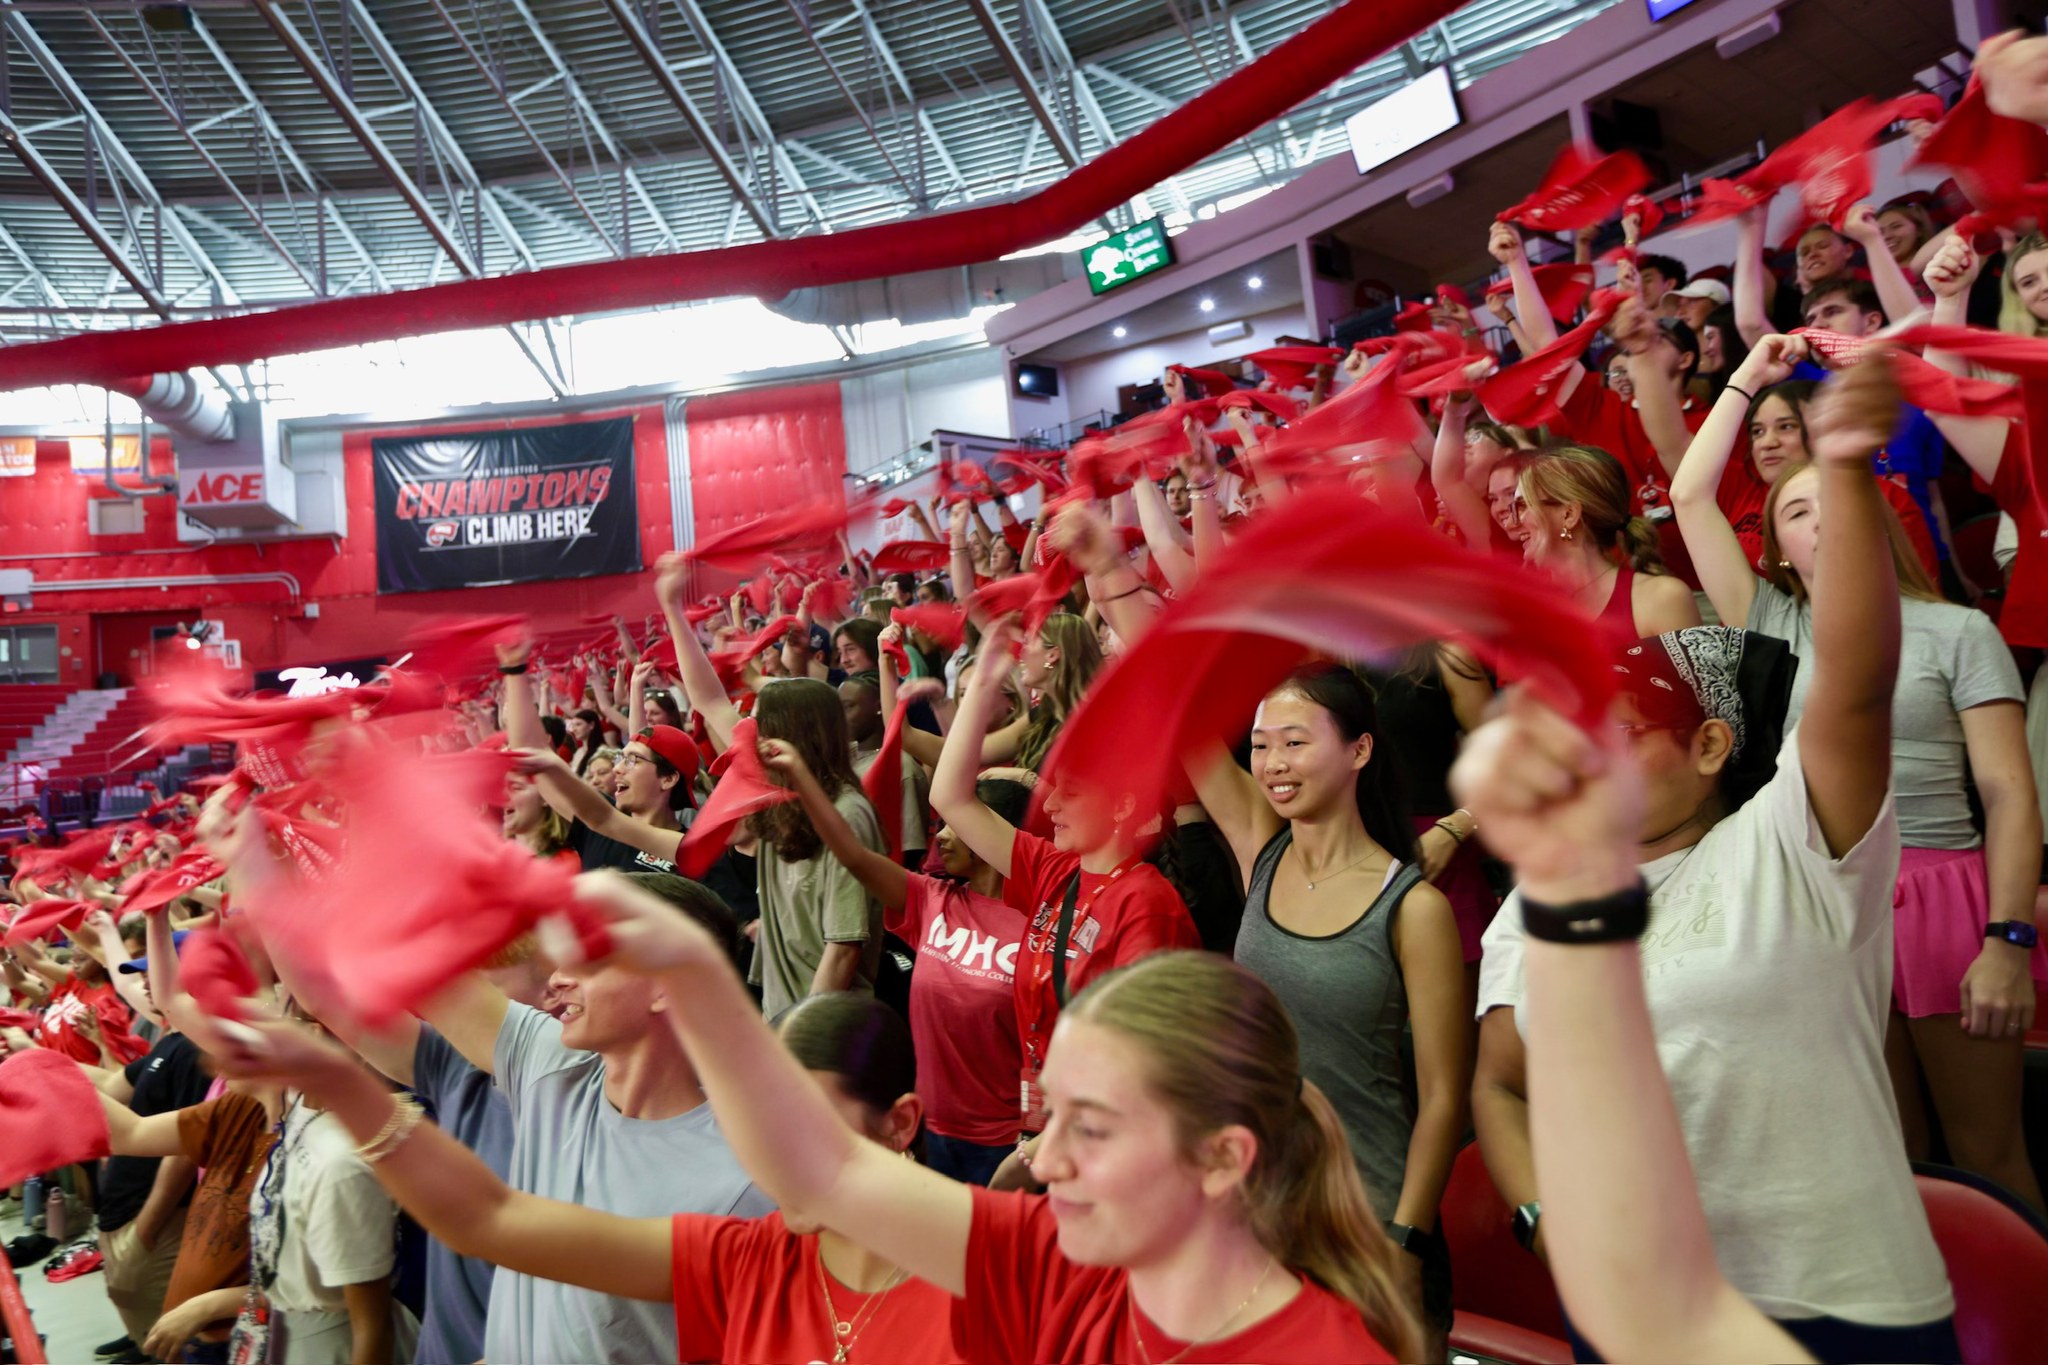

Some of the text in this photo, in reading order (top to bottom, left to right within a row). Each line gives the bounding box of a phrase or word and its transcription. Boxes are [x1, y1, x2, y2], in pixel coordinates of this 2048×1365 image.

[184, 470, 263, 504] ACE
[395, 465, 613, 521] CHAMPIONS
[467, 507, 592, 545] CLIMB HERE
[987, 971, 1015, 984] COLLE
